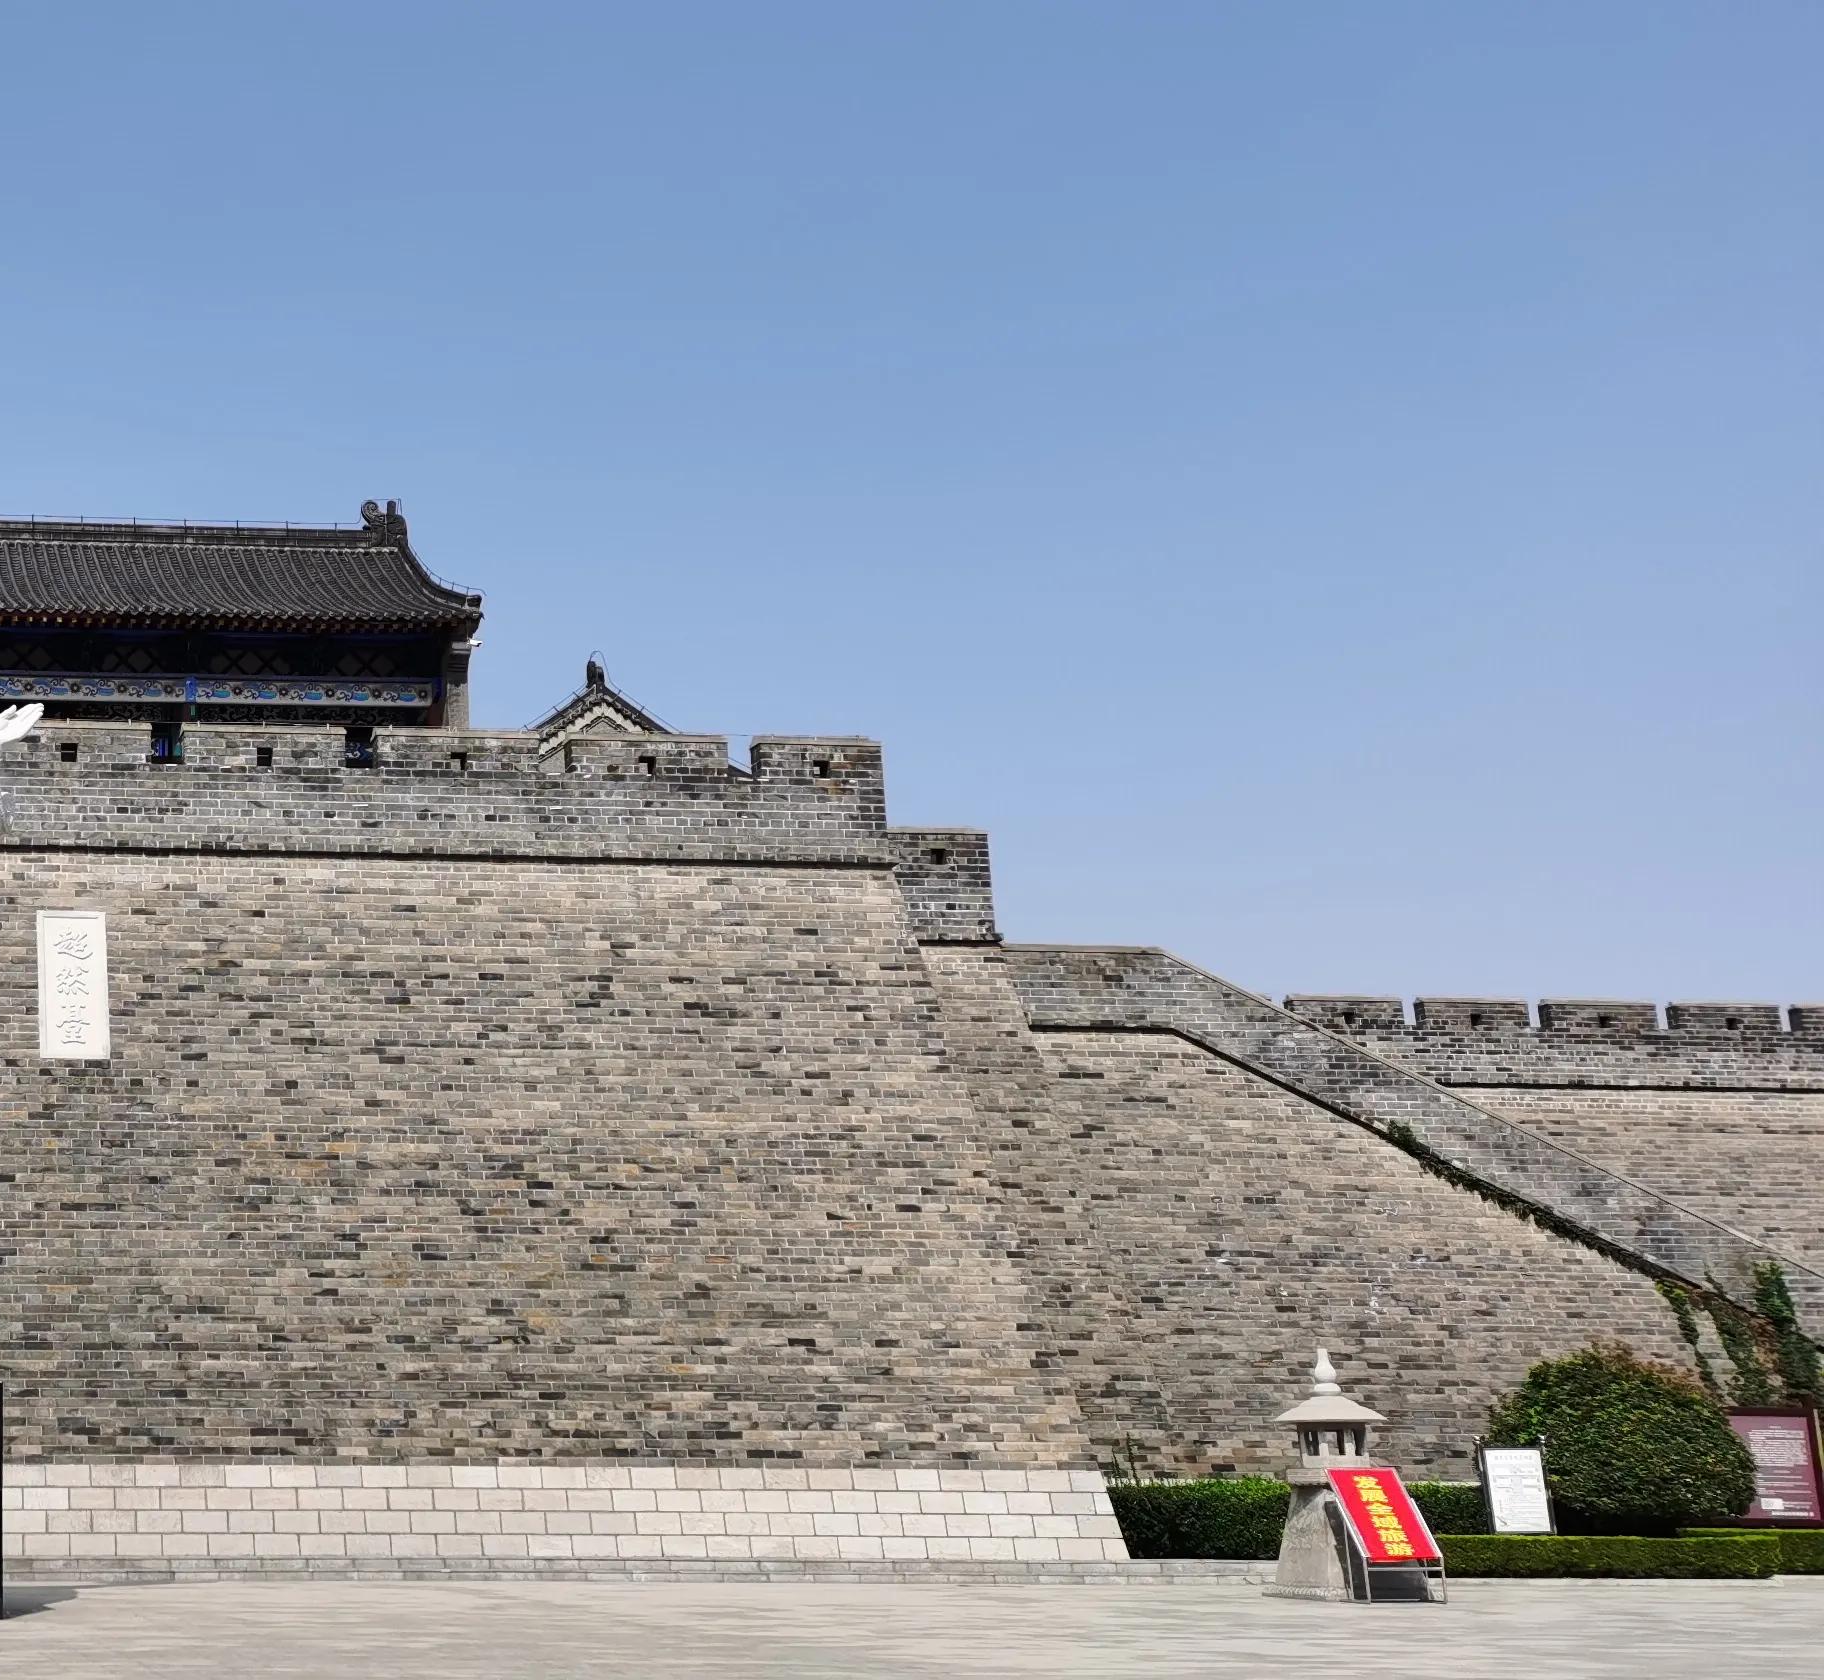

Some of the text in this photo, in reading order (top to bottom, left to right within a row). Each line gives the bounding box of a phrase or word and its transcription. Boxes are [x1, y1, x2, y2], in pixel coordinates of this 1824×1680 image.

[1352, 1475, 1415, 1556] 发展全域旅游
